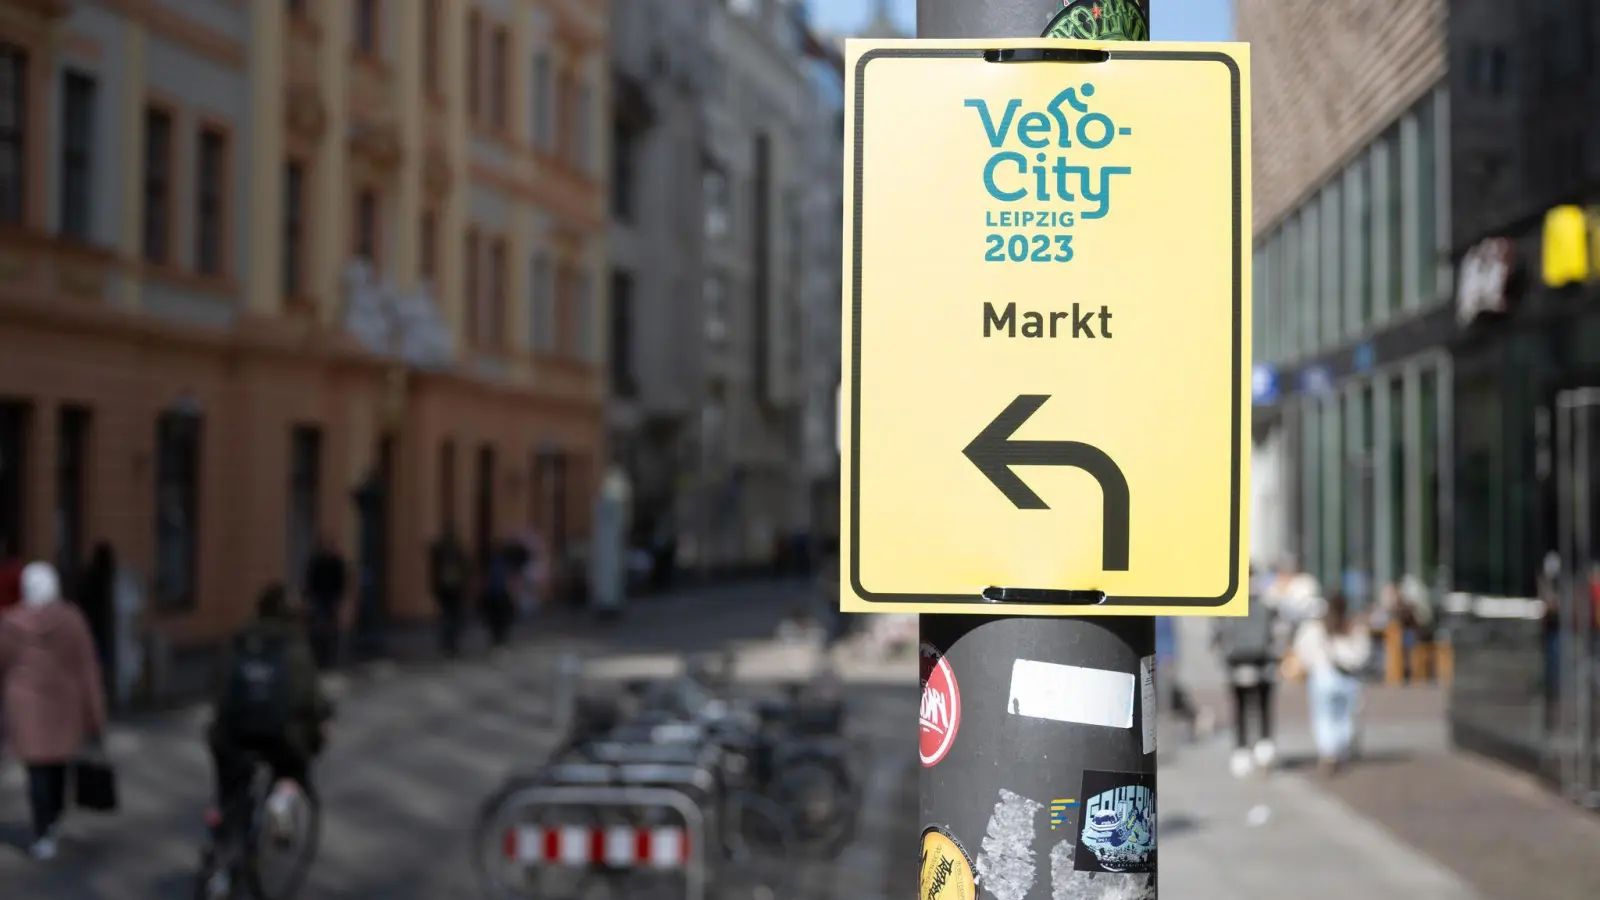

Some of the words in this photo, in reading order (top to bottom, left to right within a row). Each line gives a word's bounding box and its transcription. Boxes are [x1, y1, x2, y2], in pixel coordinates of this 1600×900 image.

[983, 151, 1132, 219] City
[985, 210, 1075, 227] LEIPZIG
[984, 234, 1074, 262] 2023
[982, 301, 1113, 338] Markt
